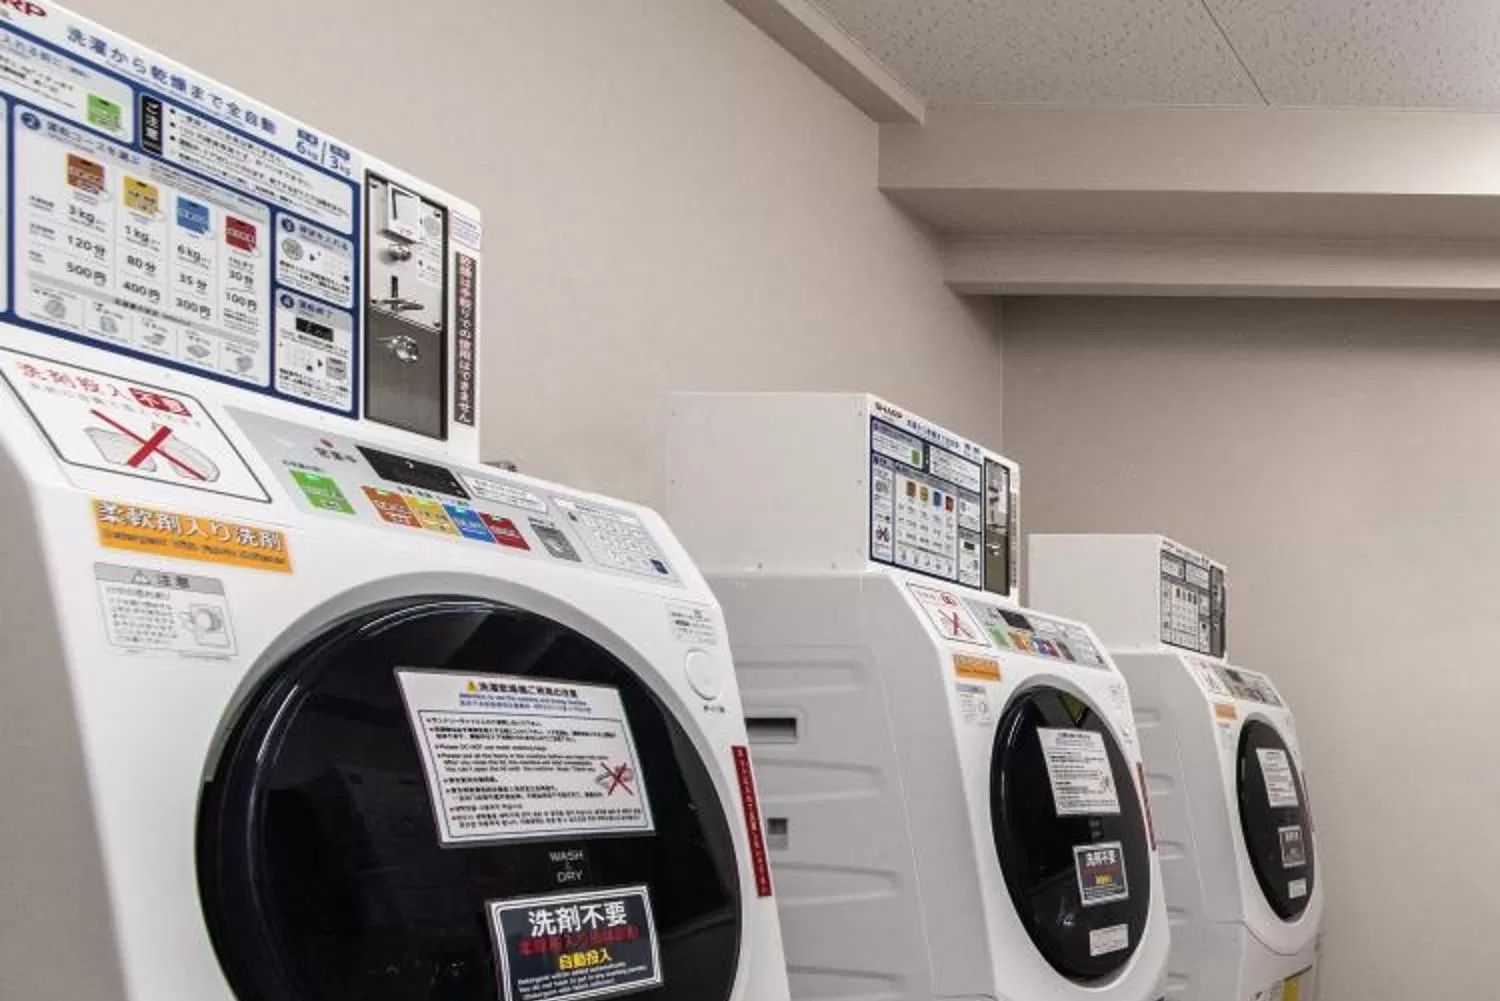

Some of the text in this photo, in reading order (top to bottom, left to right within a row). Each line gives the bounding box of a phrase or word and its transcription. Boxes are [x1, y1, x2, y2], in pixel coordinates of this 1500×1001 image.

[549, 850, 583, 861] WASH
[557, 871, 584, 882] DRY
[528, 900, 628, 937] 洗剤不要
